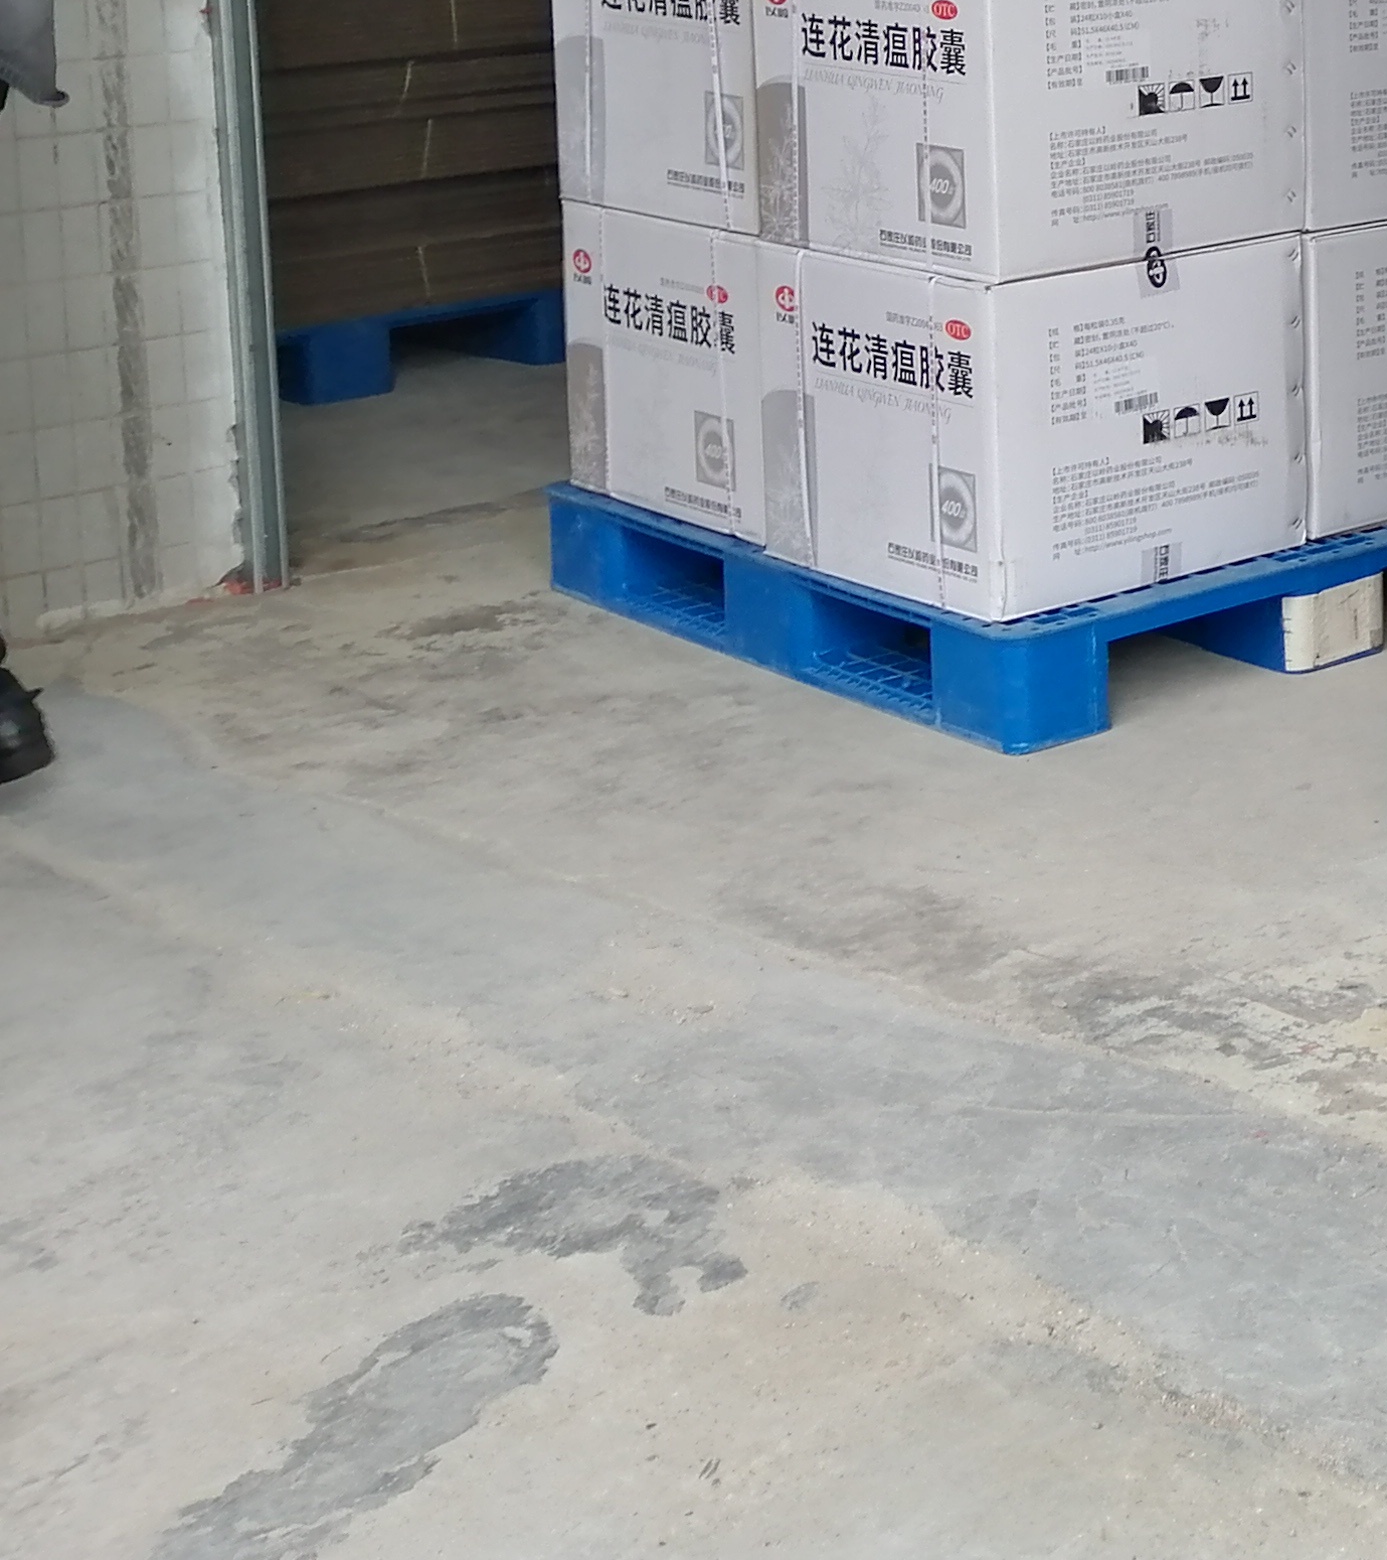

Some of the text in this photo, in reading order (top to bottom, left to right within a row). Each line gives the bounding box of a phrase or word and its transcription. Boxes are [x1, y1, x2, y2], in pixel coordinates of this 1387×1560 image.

[932, 2, 956, 19] OTC
[801, 13, 966, 76] 连花清瘟胶囊
[811, 322, 973, 399] 连花清瘟胶囊
